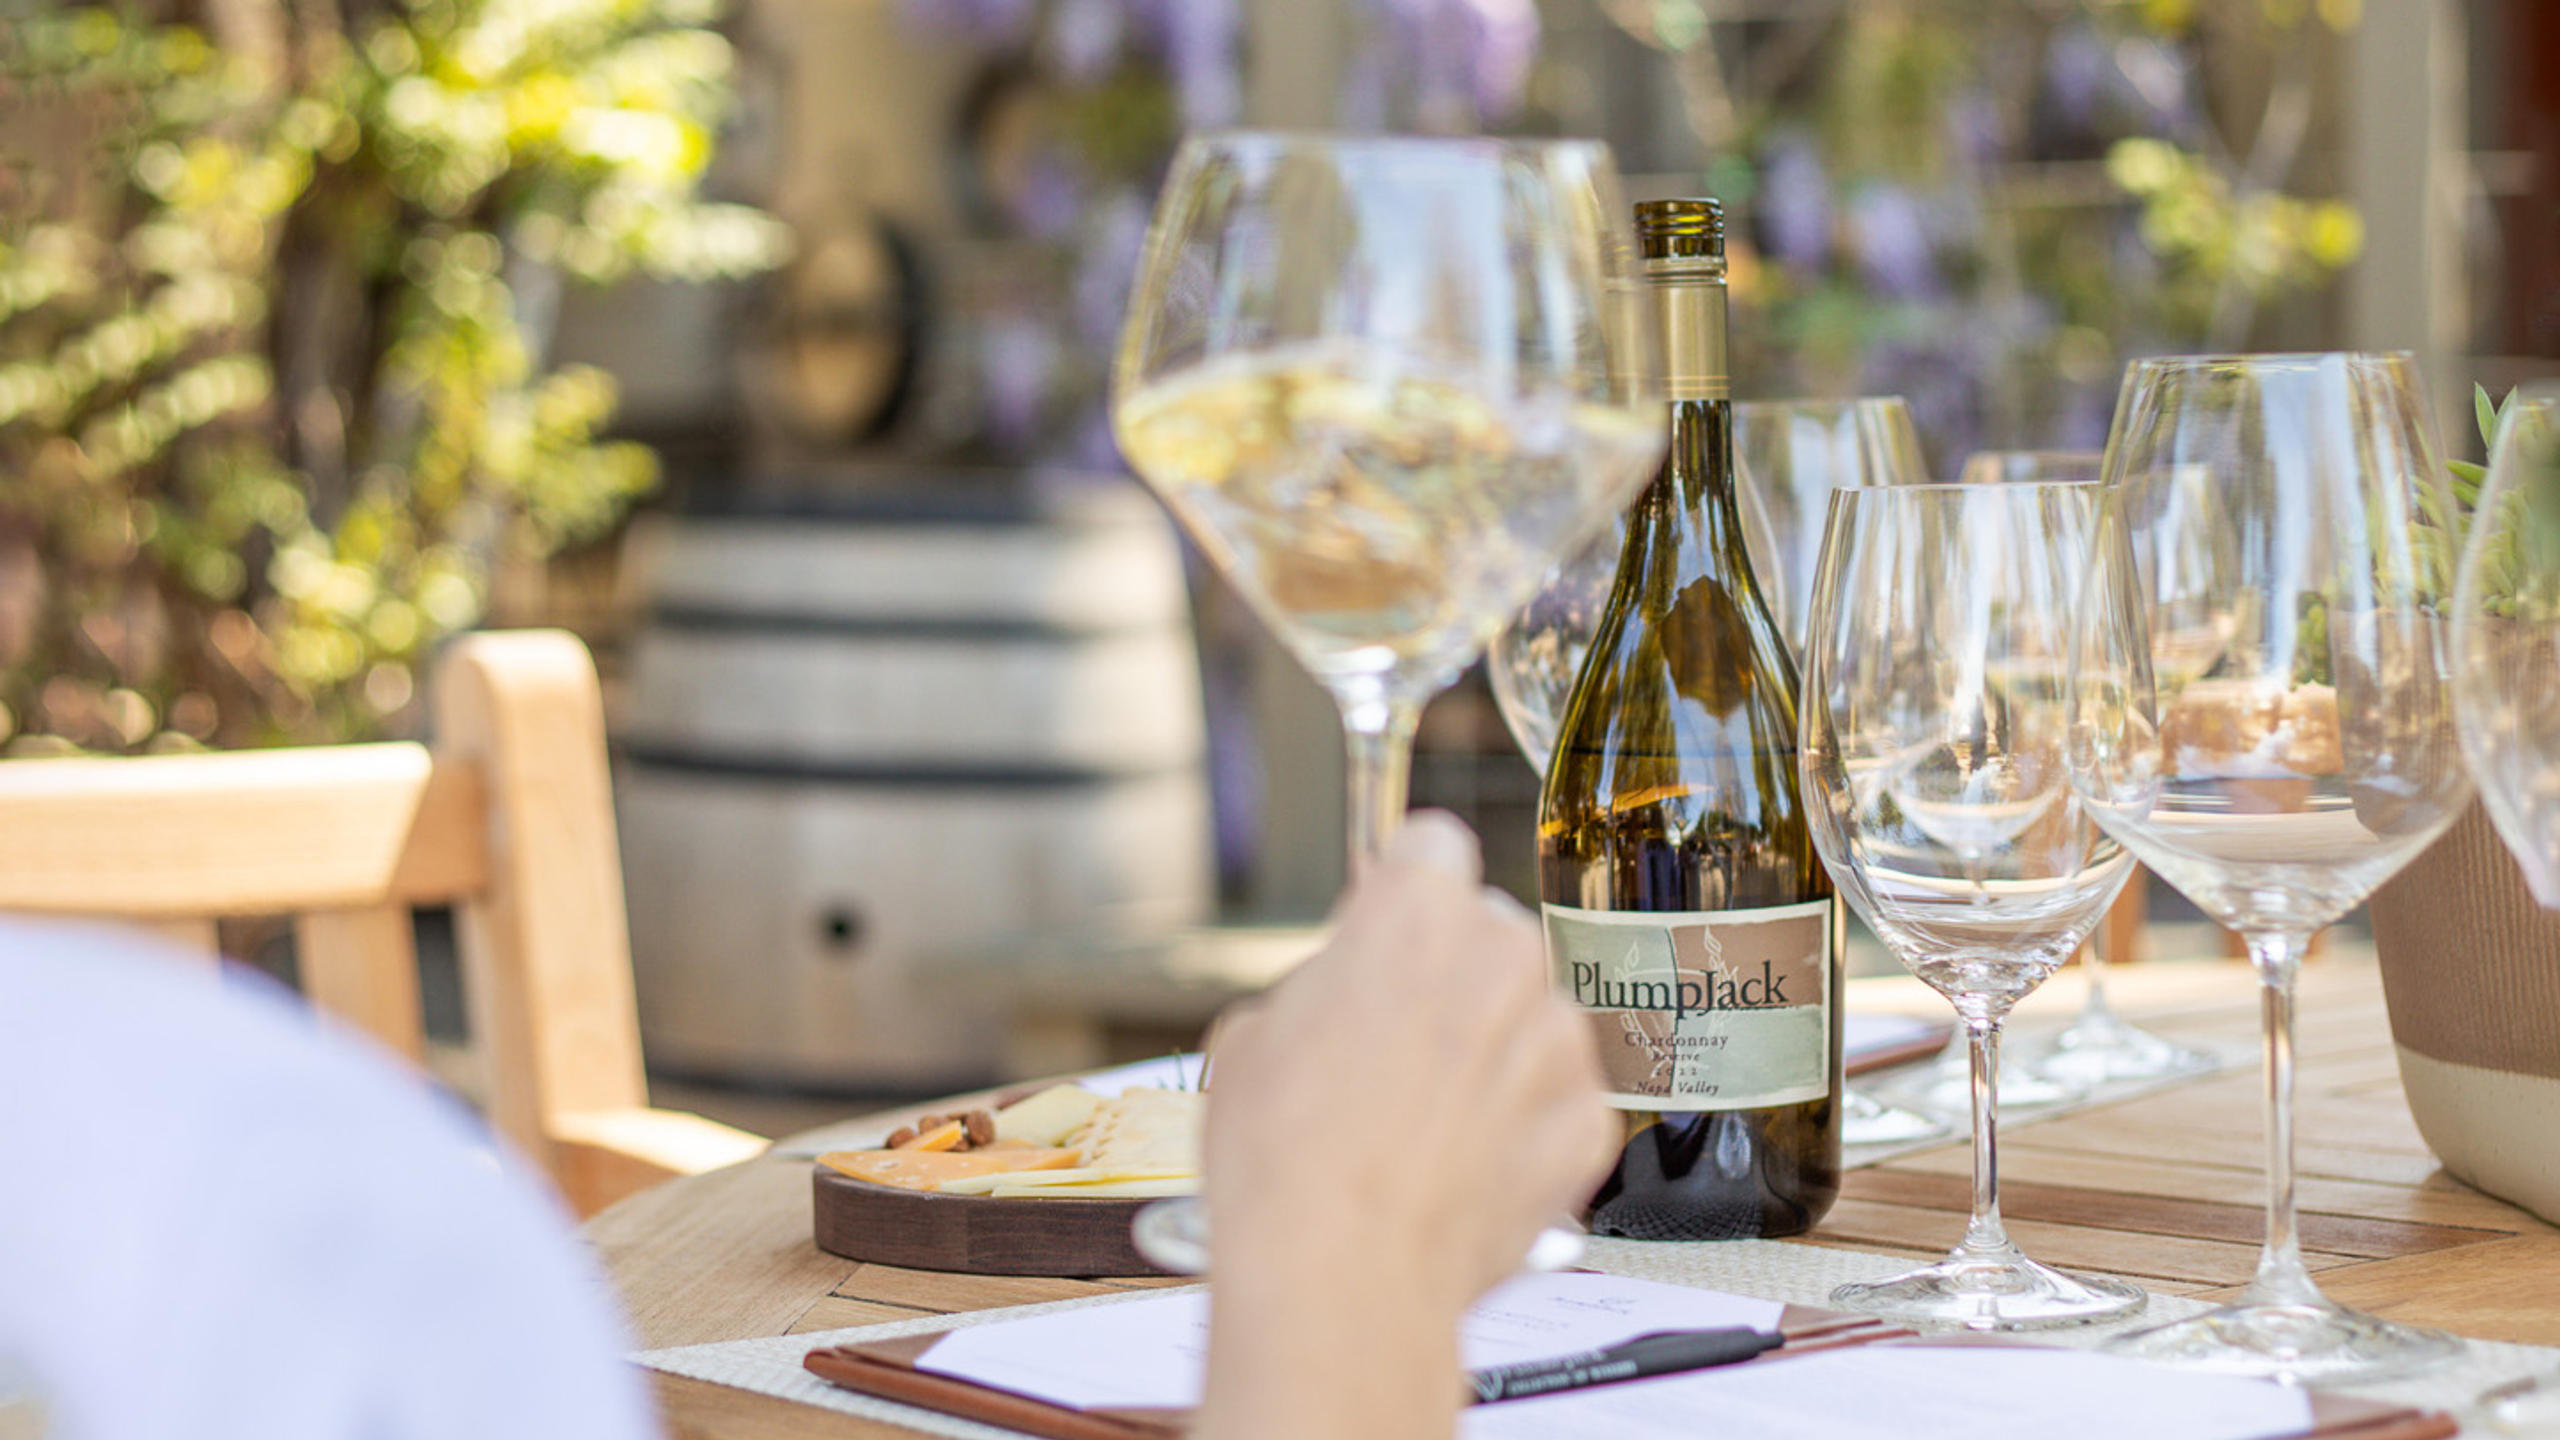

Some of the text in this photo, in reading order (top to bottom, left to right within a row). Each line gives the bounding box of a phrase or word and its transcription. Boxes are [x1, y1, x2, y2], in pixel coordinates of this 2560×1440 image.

[1572, 960, 1789, 1020] PlumpJack
[1624, 1032, 1729, 1050] Chardonnay
[1636, 1079, 1720, 1097] Napa Valley
